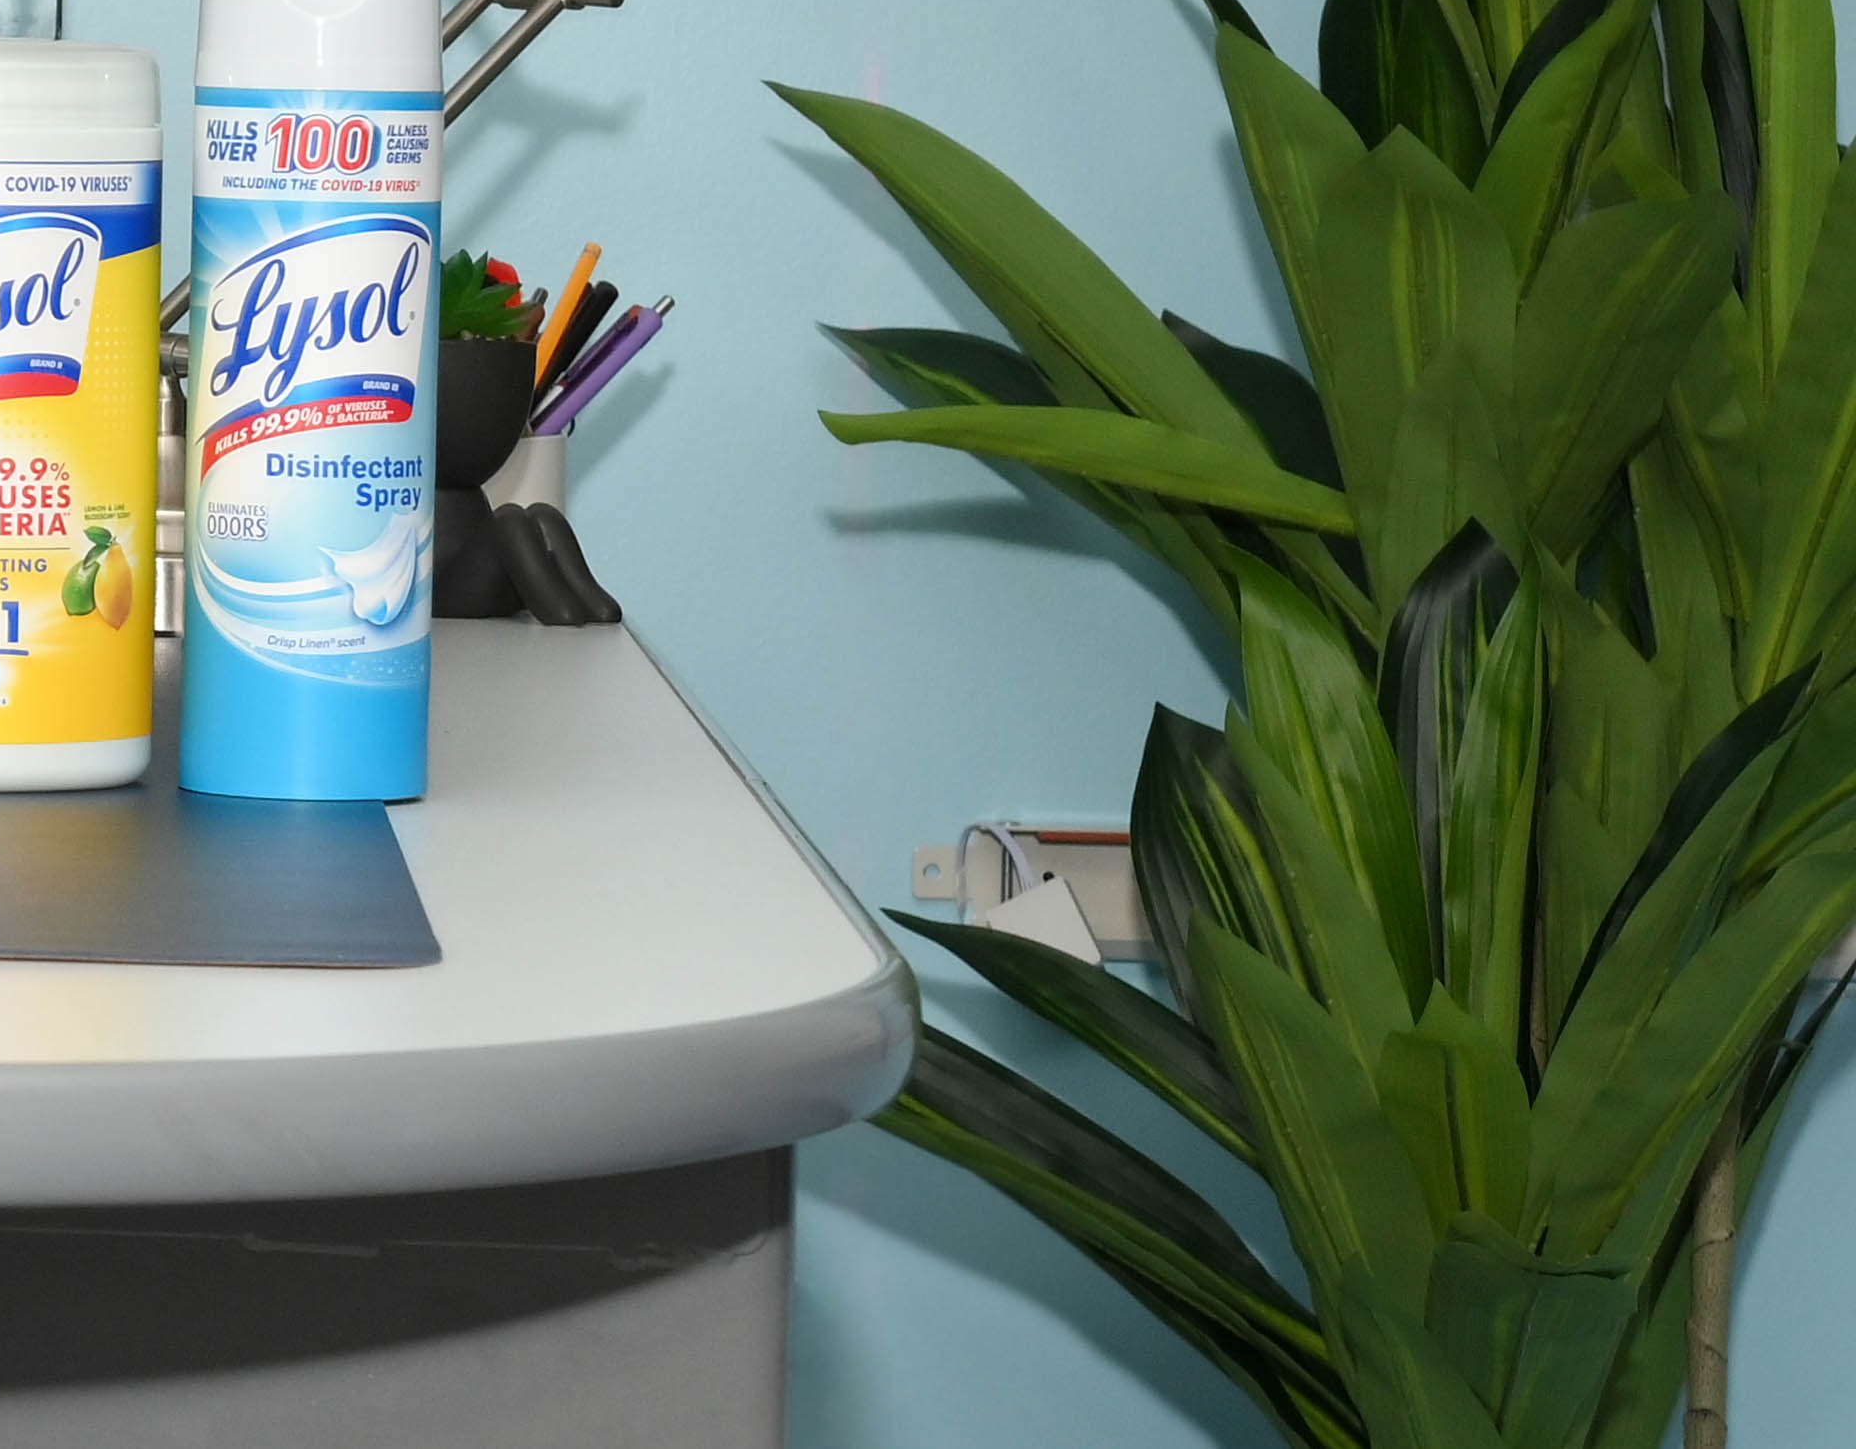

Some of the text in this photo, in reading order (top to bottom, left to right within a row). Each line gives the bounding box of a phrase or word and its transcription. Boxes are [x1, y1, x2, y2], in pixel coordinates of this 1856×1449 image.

[206, 119, 258, 141] KILLS
[387, 125, 427, 137] ILLNESS
[208, 140, 257, 162] OVER
[266, 114, 374, 175] 100
[387, 137, 428, 150] CAUSING
[386, 152, 421, 164] GERMS
[5, 176, 76, 192] COVID-19
[222, 176, 287, 191] INCLUDING
[291, 178, 318, 192] THE
[321, 179, 382, 192] COVID-19
[327, 400, 387, 414] OF VIRUSES
[325, 415, 334, 425] &
[215, 406, 322, 454] KILLS 99.9%
[266, 453, 422, 479] Disinfectant
[355, 483, 422, 512] Spray
[208, 502, 266, 516] ELIMINATES
[207, 514, 267, 538] ODORS
[1, 601, 20, 643] 1
[267, 635, 296, 649] Crisp
[337, 636, 366, 648] scent
